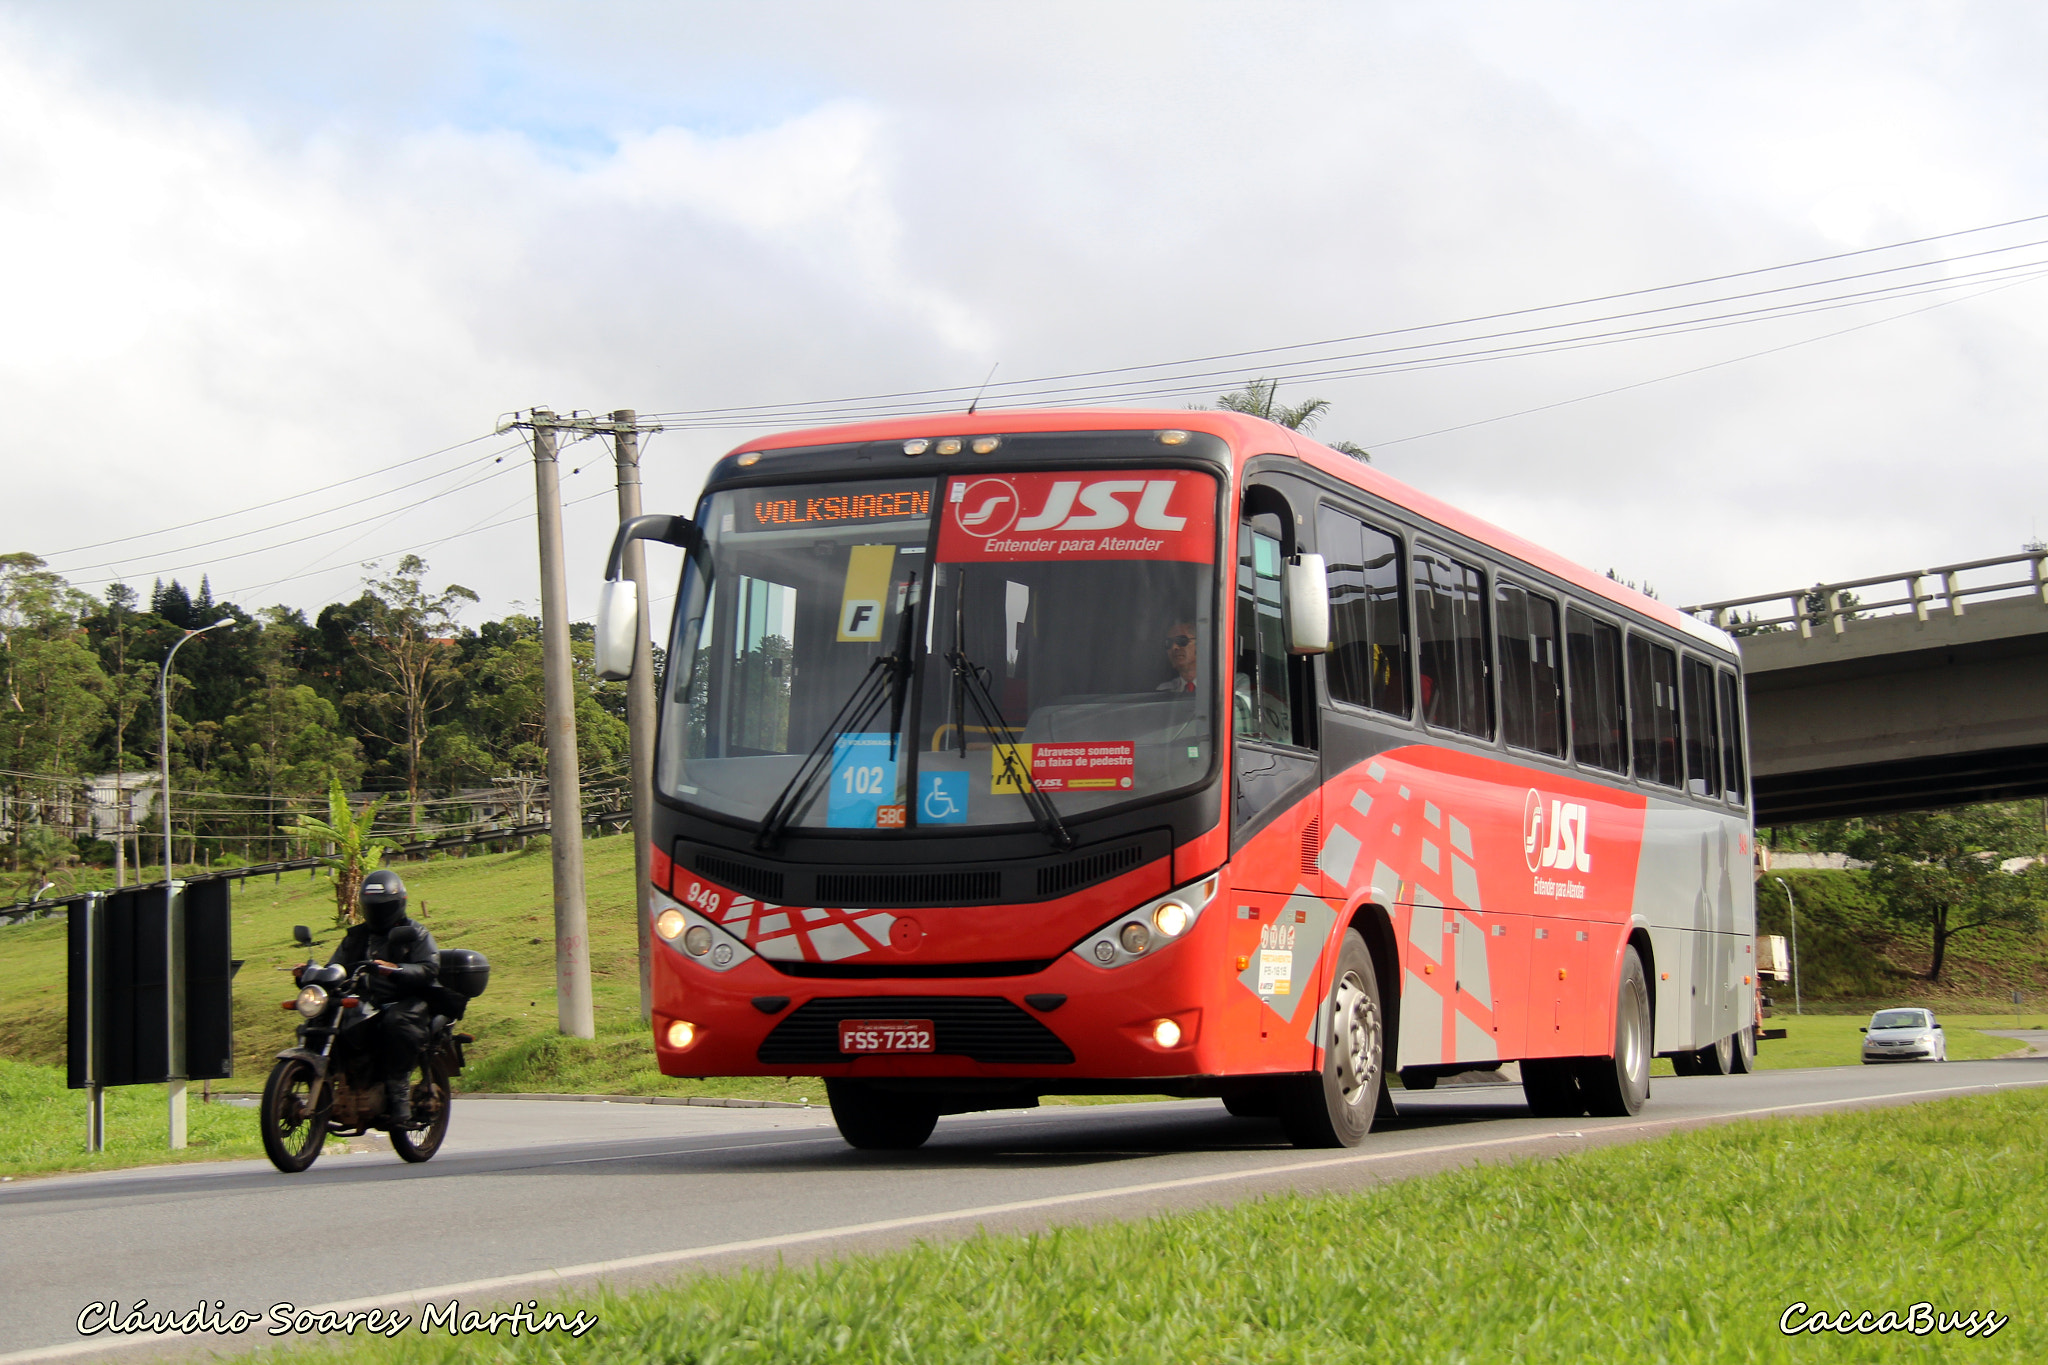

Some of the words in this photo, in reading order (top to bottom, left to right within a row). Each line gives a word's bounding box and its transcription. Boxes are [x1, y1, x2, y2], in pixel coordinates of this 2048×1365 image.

[755, 490, 930, 525] VOLKSWAGEN
[1014, 480, 1187, 531] JSL
[984, 538, 1057, 552] Entender
[1057, 539, 1098, 554] para
[1098, 537, 1164, 551] Atender
[849, 606, 874, 631] F
[1033, 759, 1046, 768] na
[1048, 757, 1073, 767] faixa
[1075, 756, 1087, 767] de
[1090, 756, 1133, 767] pedestre
[1037, 747, 1086, 757] Atravesse
[1087, 745, 1130, 756] somente
[842, 766, 884, 794] 102
[878, 808, 905, 824] SBC
[1542, 800, 1591, 873] JSL
[687, 882, 720, 913] 949
[1534, 876, 1555, 896] Entender
[1555, 882, 1567, 900] para
[1567, 880, 1585, 899] Atender
